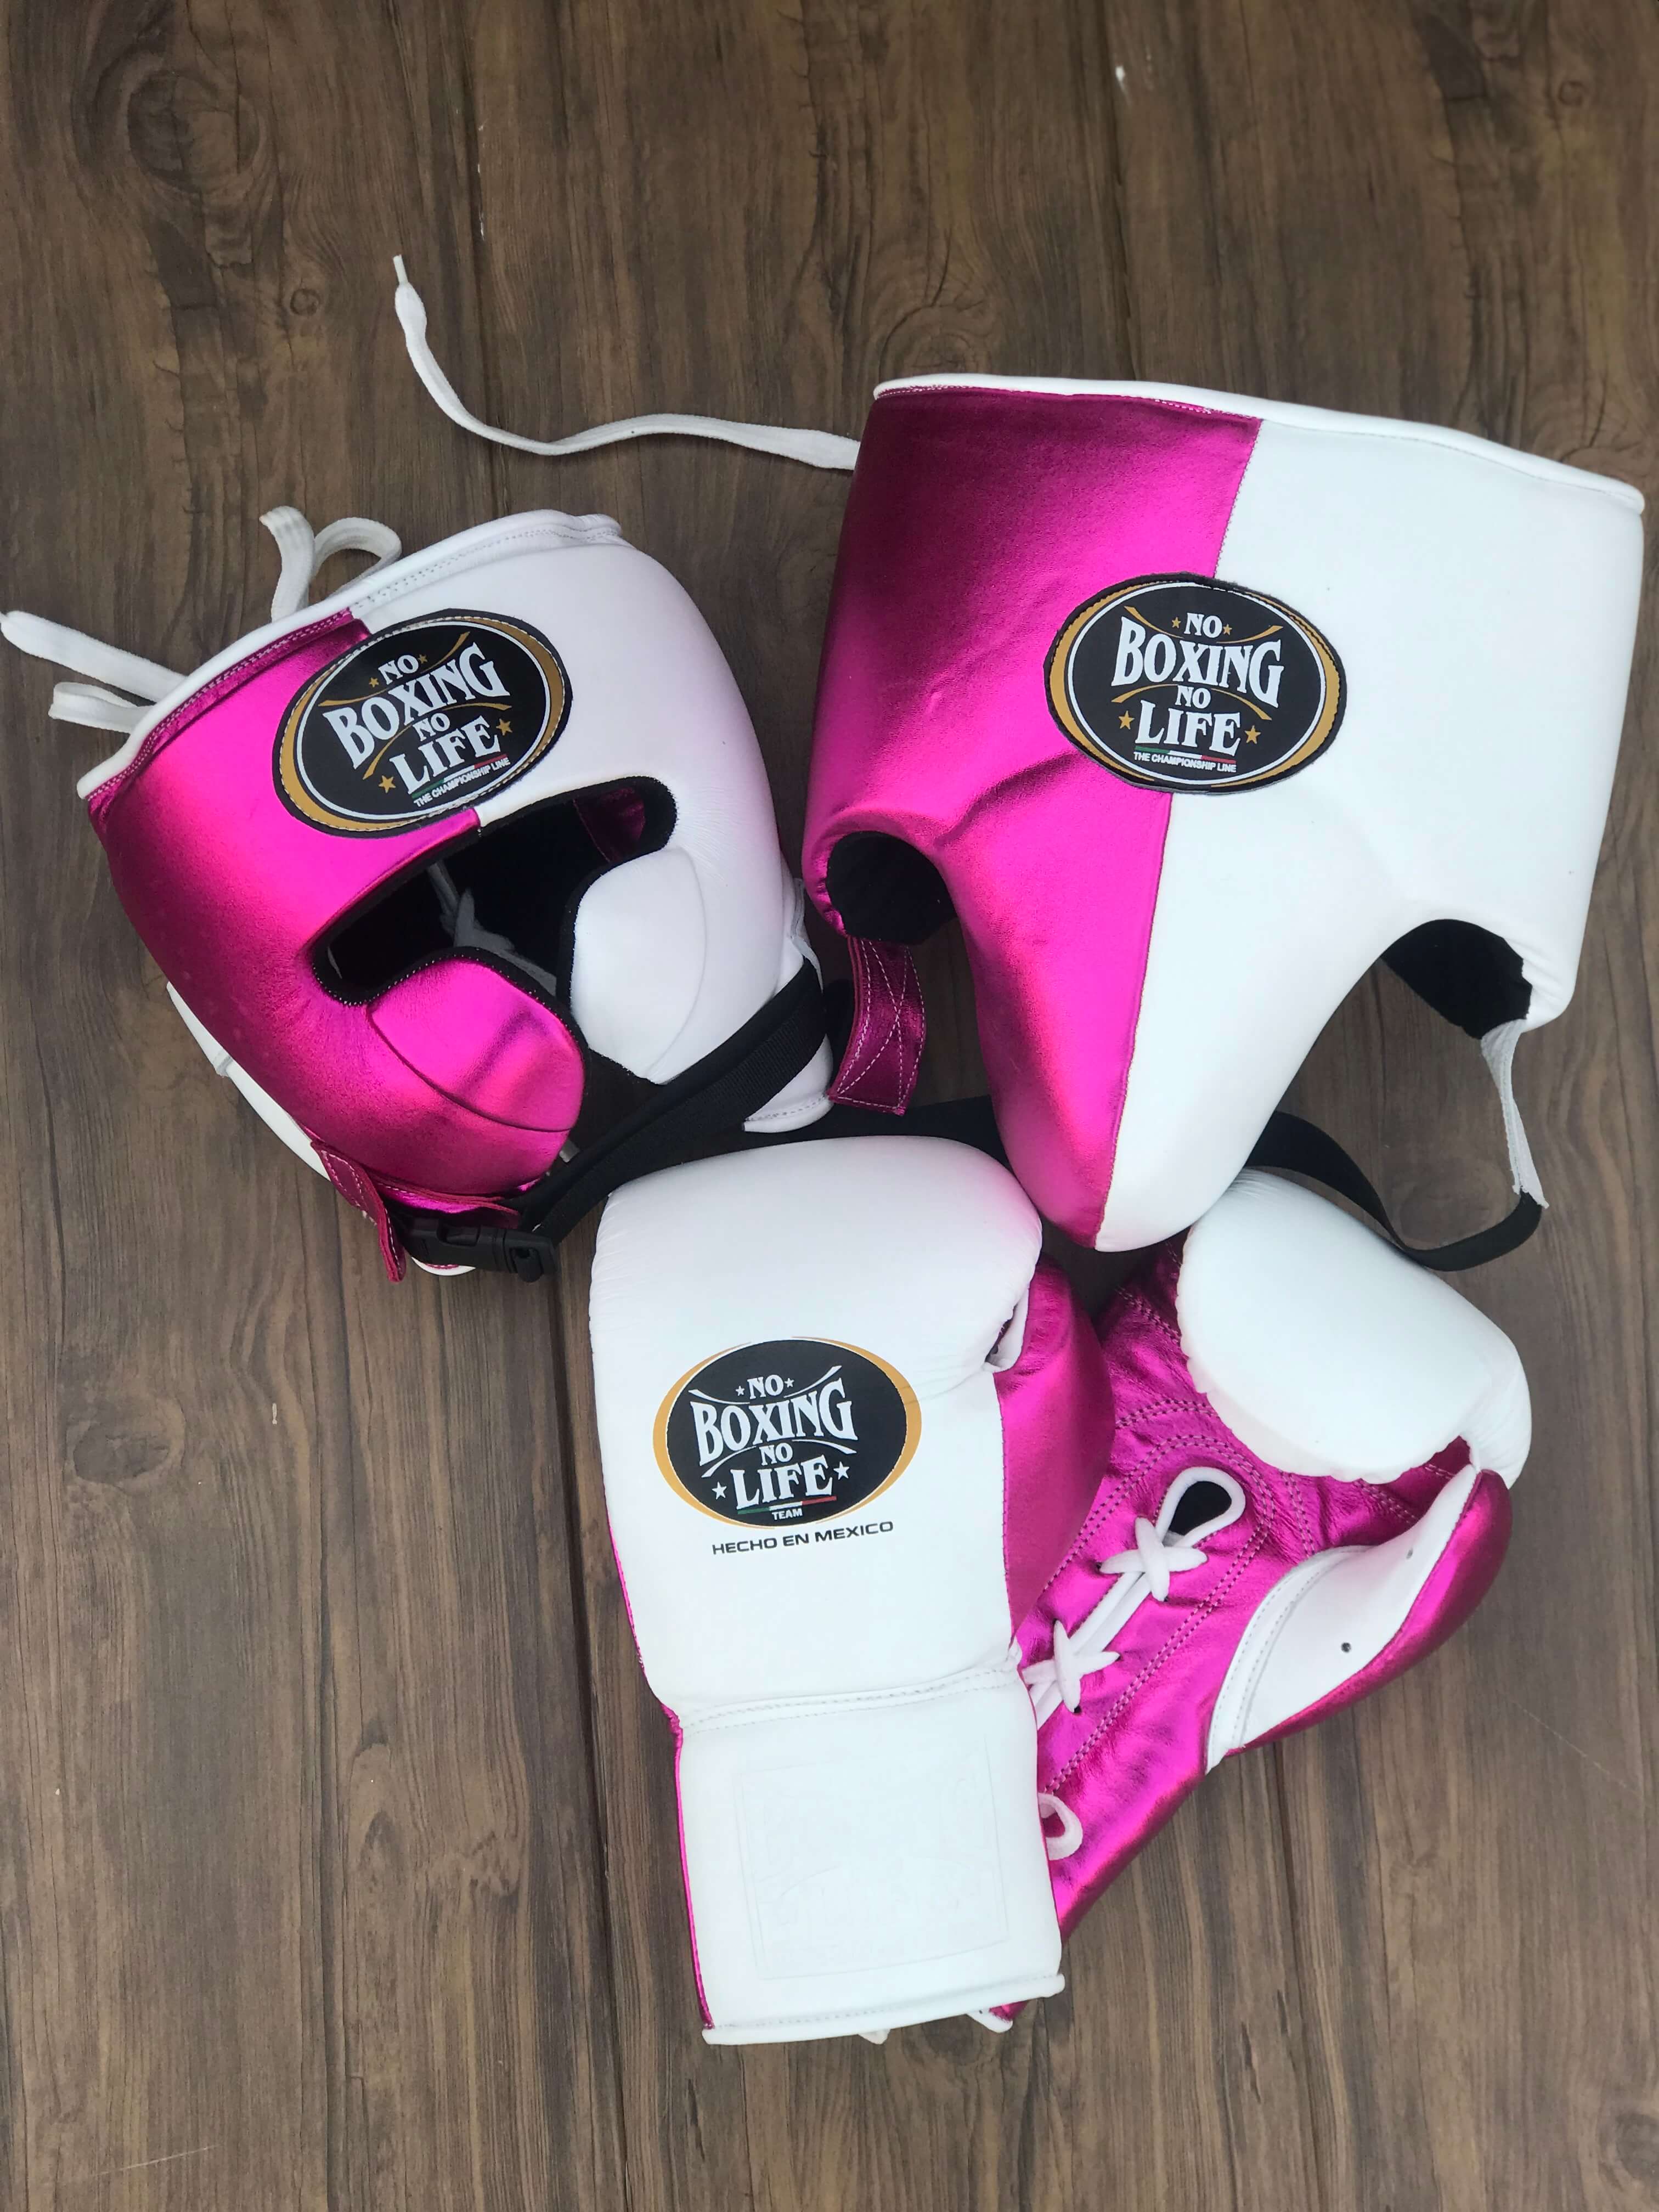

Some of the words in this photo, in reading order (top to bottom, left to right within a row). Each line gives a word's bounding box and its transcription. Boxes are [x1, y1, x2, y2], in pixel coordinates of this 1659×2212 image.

[1184, 613, 1222, 638] NO
[378, 655, 419, 685] NO
[1111, 616, 1284, 708] BOXING
[323, 642, 510, 769] BOXING
[1176, 685, 1211, 709] NO
[413, 713, 450, 741] NO
[1135, 700, 1240, 757] LIFE
[390, 715, 500, 794] LIFE
[1133, 752, 1150, 761] THE
[1152, 754, 1216, 770] CHAMPIONSHIP
[1217, 763, 1237, 772] LINE
[414, 793, 433, 807] THE
[432, 766, 491, 797] CHAMPIONSHIP
[490, 757, 511, 769] LINE
[747, 1375, 783, 1400] NO
[690, 1378, 858, 1466] BOXING
[759, 1443, 793, 1466] NO
[730, 1454, 833, 1510] LIFE
[772, 1508, 803, 1520] TEAM
[712, 1537, 777, 1554] HECHO
[783, 1533, 809, 1547] EN
[816, 1521, 893, 1542] MEXICO
